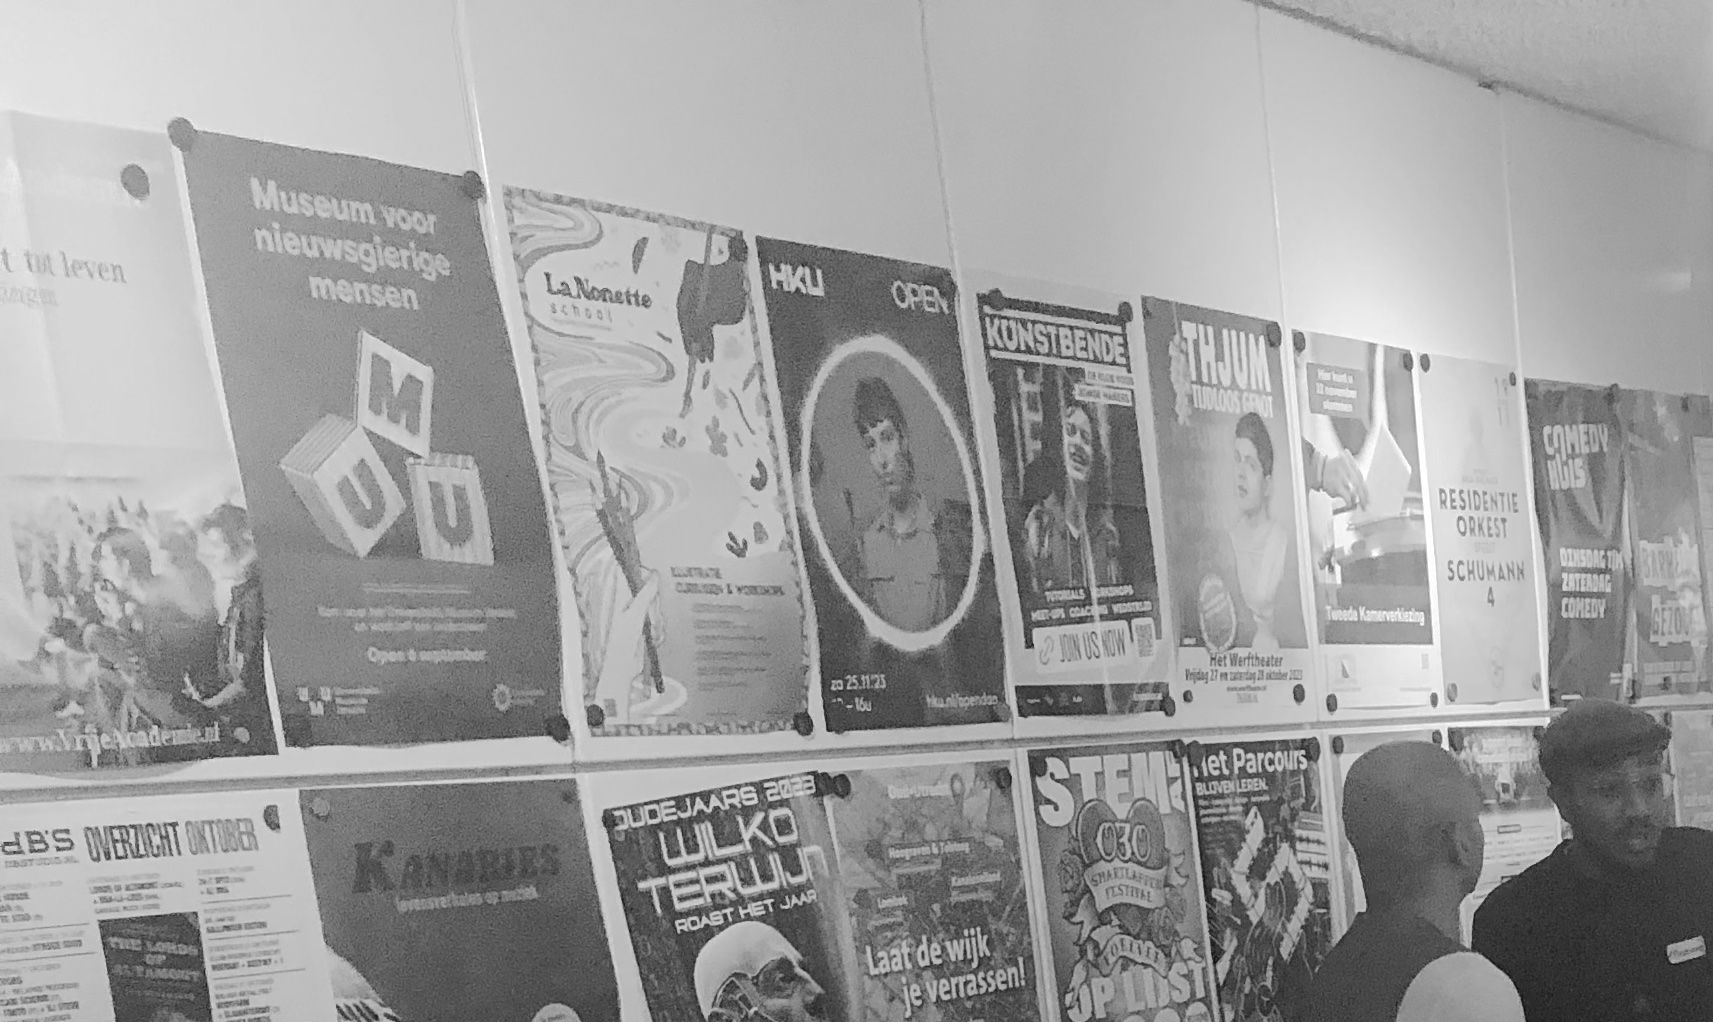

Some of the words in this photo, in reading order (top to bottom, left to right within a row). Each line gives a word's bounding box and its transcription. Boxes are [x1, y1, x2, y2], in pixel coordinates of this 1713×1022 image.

[251, 177, 376, 226] Museum
[380, 204, 437, 235] voor
[59, 250, 128, 284] leven
[254, 221, 451, 282] nieuwsgierige
[308, 275, 420, 311] mensen
[767, 262, 825, 297] HKU
[889, 279, 952, 315] OPEN
[984, 316, 1128, 366] KUNSTBENDE
[1181, 320, 1272, 393] THJUM
[1543, 422, 1608, 460] COMEDY
[1438, 487, 1520, 514] RESIDENTIE
[1456, 515, 1508, 539] ORKEST
[1447, 559, 1526, 582] SCHUMANN
[1559, 547, 1606, 568] DINSDAG
[1486, 586, 1496, 607] 4
[1561, 573, 1612, 593] ZATERDAG
[1325, 605, 1358, 622] Tweede
[1358, 605, 1425, 627] Kamerverkiezing
[1561, 597, 1606, 619] COMEDY
[1058, 633, 1082, 664] JOIN
[1081, 630, 1101, 661] US
[1101, 627, 1128, 658] NOW
[1209, 652, 1228, 667] Het
[1229, 651, 1284, 668] Werftheater
[1232, 747, 1308, 773] Parcours
[84, 821, 183, 863] OVERZICHT
[185, 818, 260, 856] OKTOBER
[658, 807, 799, 868] WILKO
[1096, 821, 1151, 862] 030
[636, 844, 830, 917] TERWIJN
[675, 907, 736, 935] ROAST
[738, 898, 776, 920] HET
[779, 889, 818, 911] JAAR
[865, 945, 914, 977] Laat
[916, 934, 943, 968] de
[945, 926, 991, 969] wijk
[901, 975, 923, 1019] je
[925, 956, 1027, 1003] verrassen!
